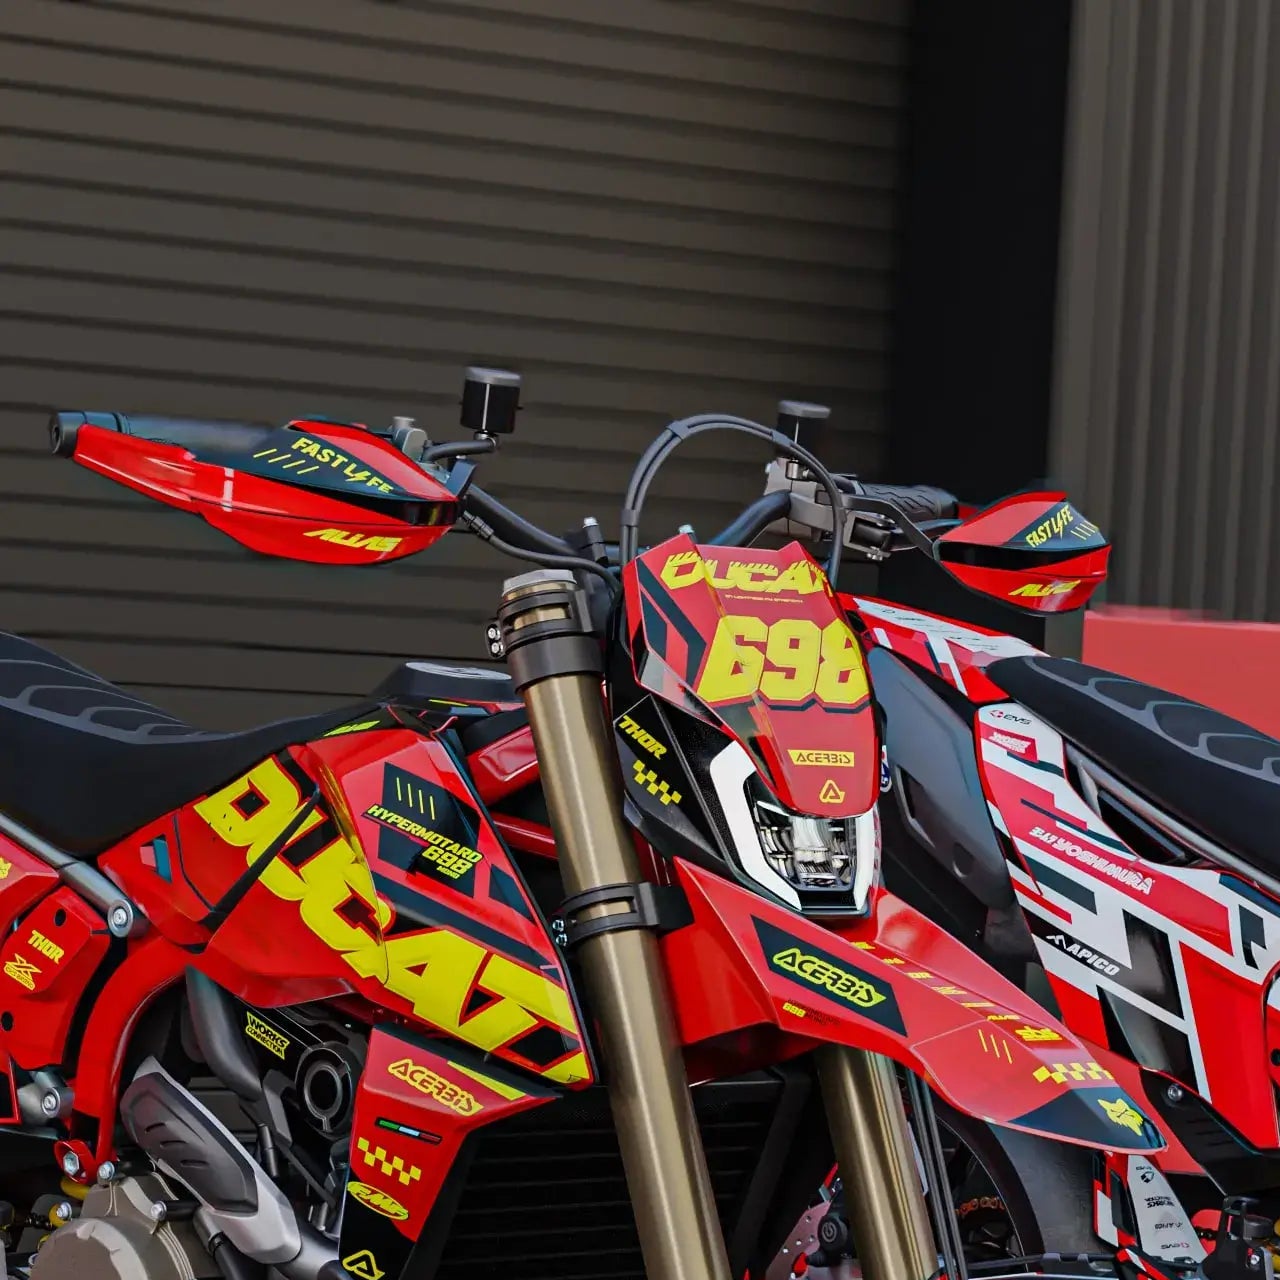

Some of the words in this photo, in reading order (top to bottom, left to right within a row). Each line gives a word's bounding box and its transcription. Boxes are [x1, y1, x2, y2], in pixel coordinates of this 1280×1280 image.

[292, 438, 348, 468] FAST
[697, 615, 870, 704] 698
[618, 715, 667, 760] THOR
[367, 804, 483, 864] HYPERMOTARD
[421, 845, 473, 876] 698
[1052, 837, 1153, 895] YOSHIMURA
[28, 930, 64, 964] THOR
[1066, 943, 1120, 976] APICO
[248, 1014, 289, 1048] WORKS
